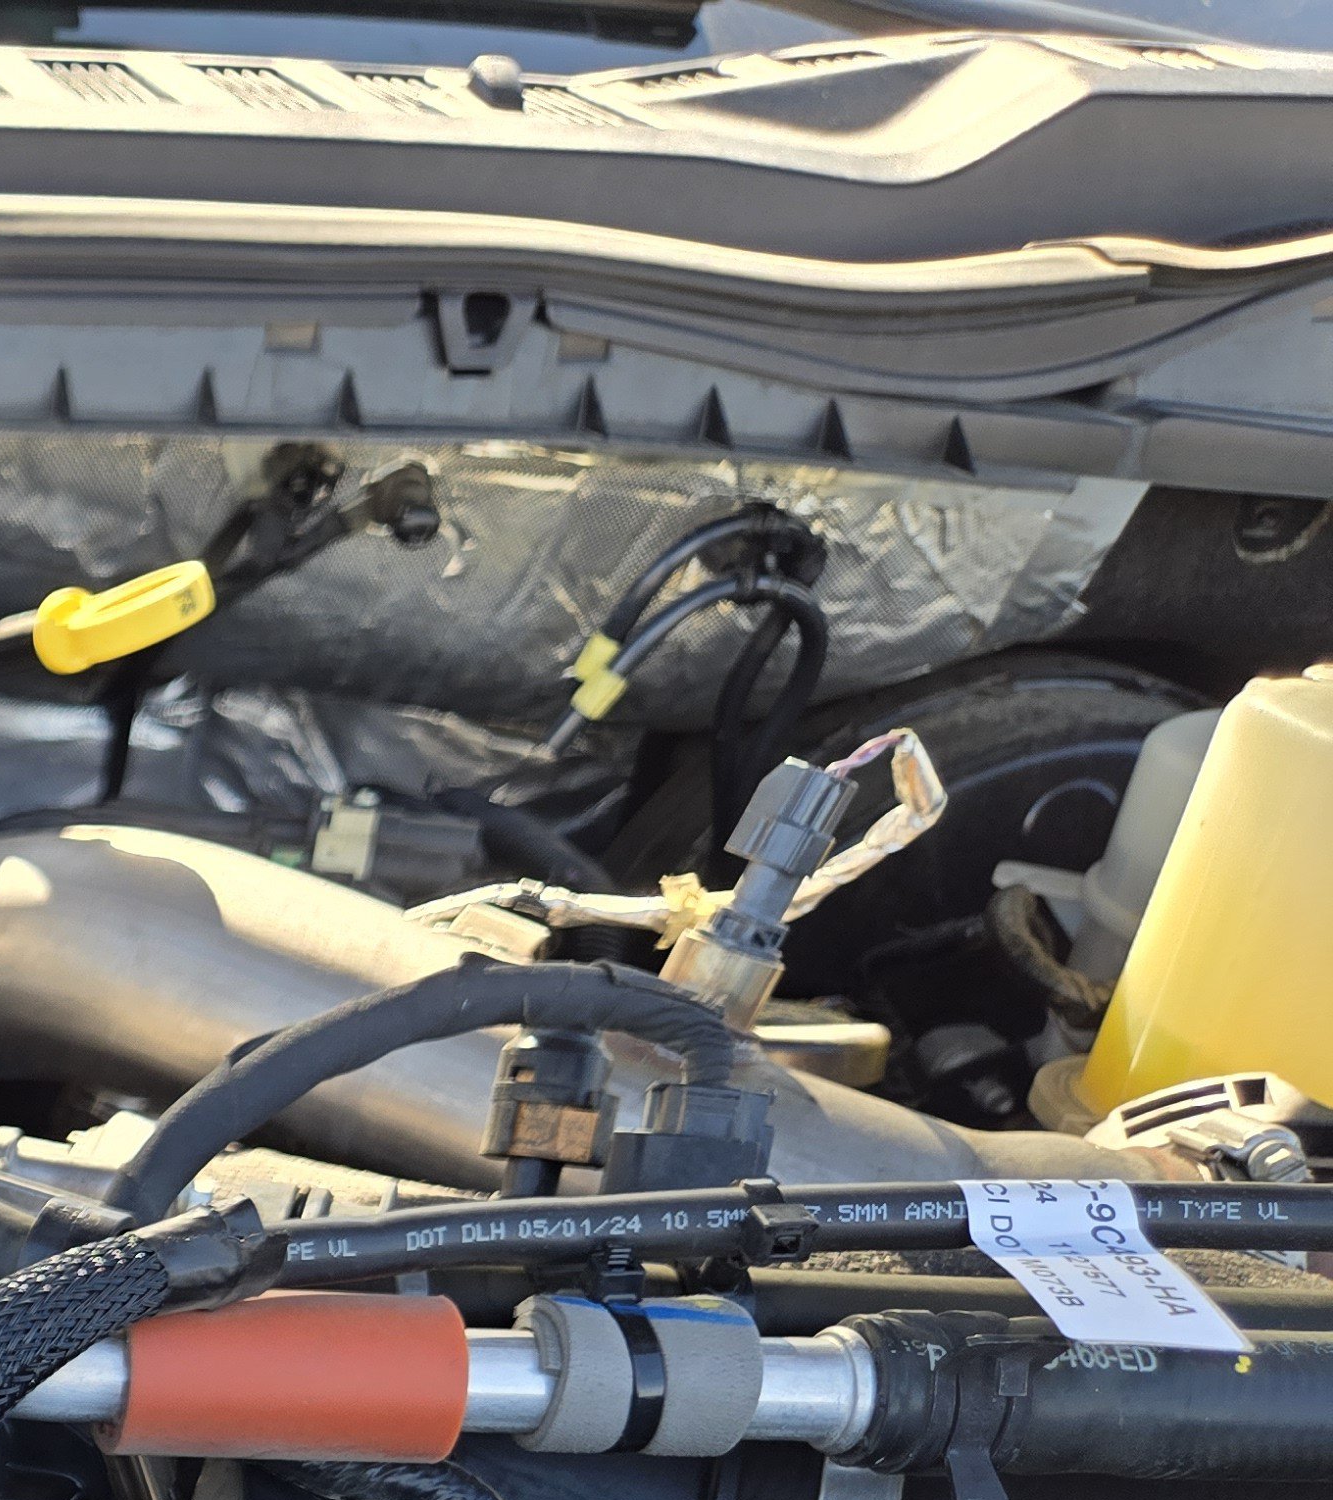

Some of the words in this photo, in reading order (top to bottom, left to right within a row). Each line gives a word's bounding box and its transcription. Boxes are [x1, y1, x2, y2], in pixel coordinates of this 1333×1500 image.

[406, 1226, 447, 1252] DOT
[461, 1221, 505, 1244] DLH
[518, 1204, 642, 1240] 05/01/24
[1178, 1200, 1242, 1220] TYPE
